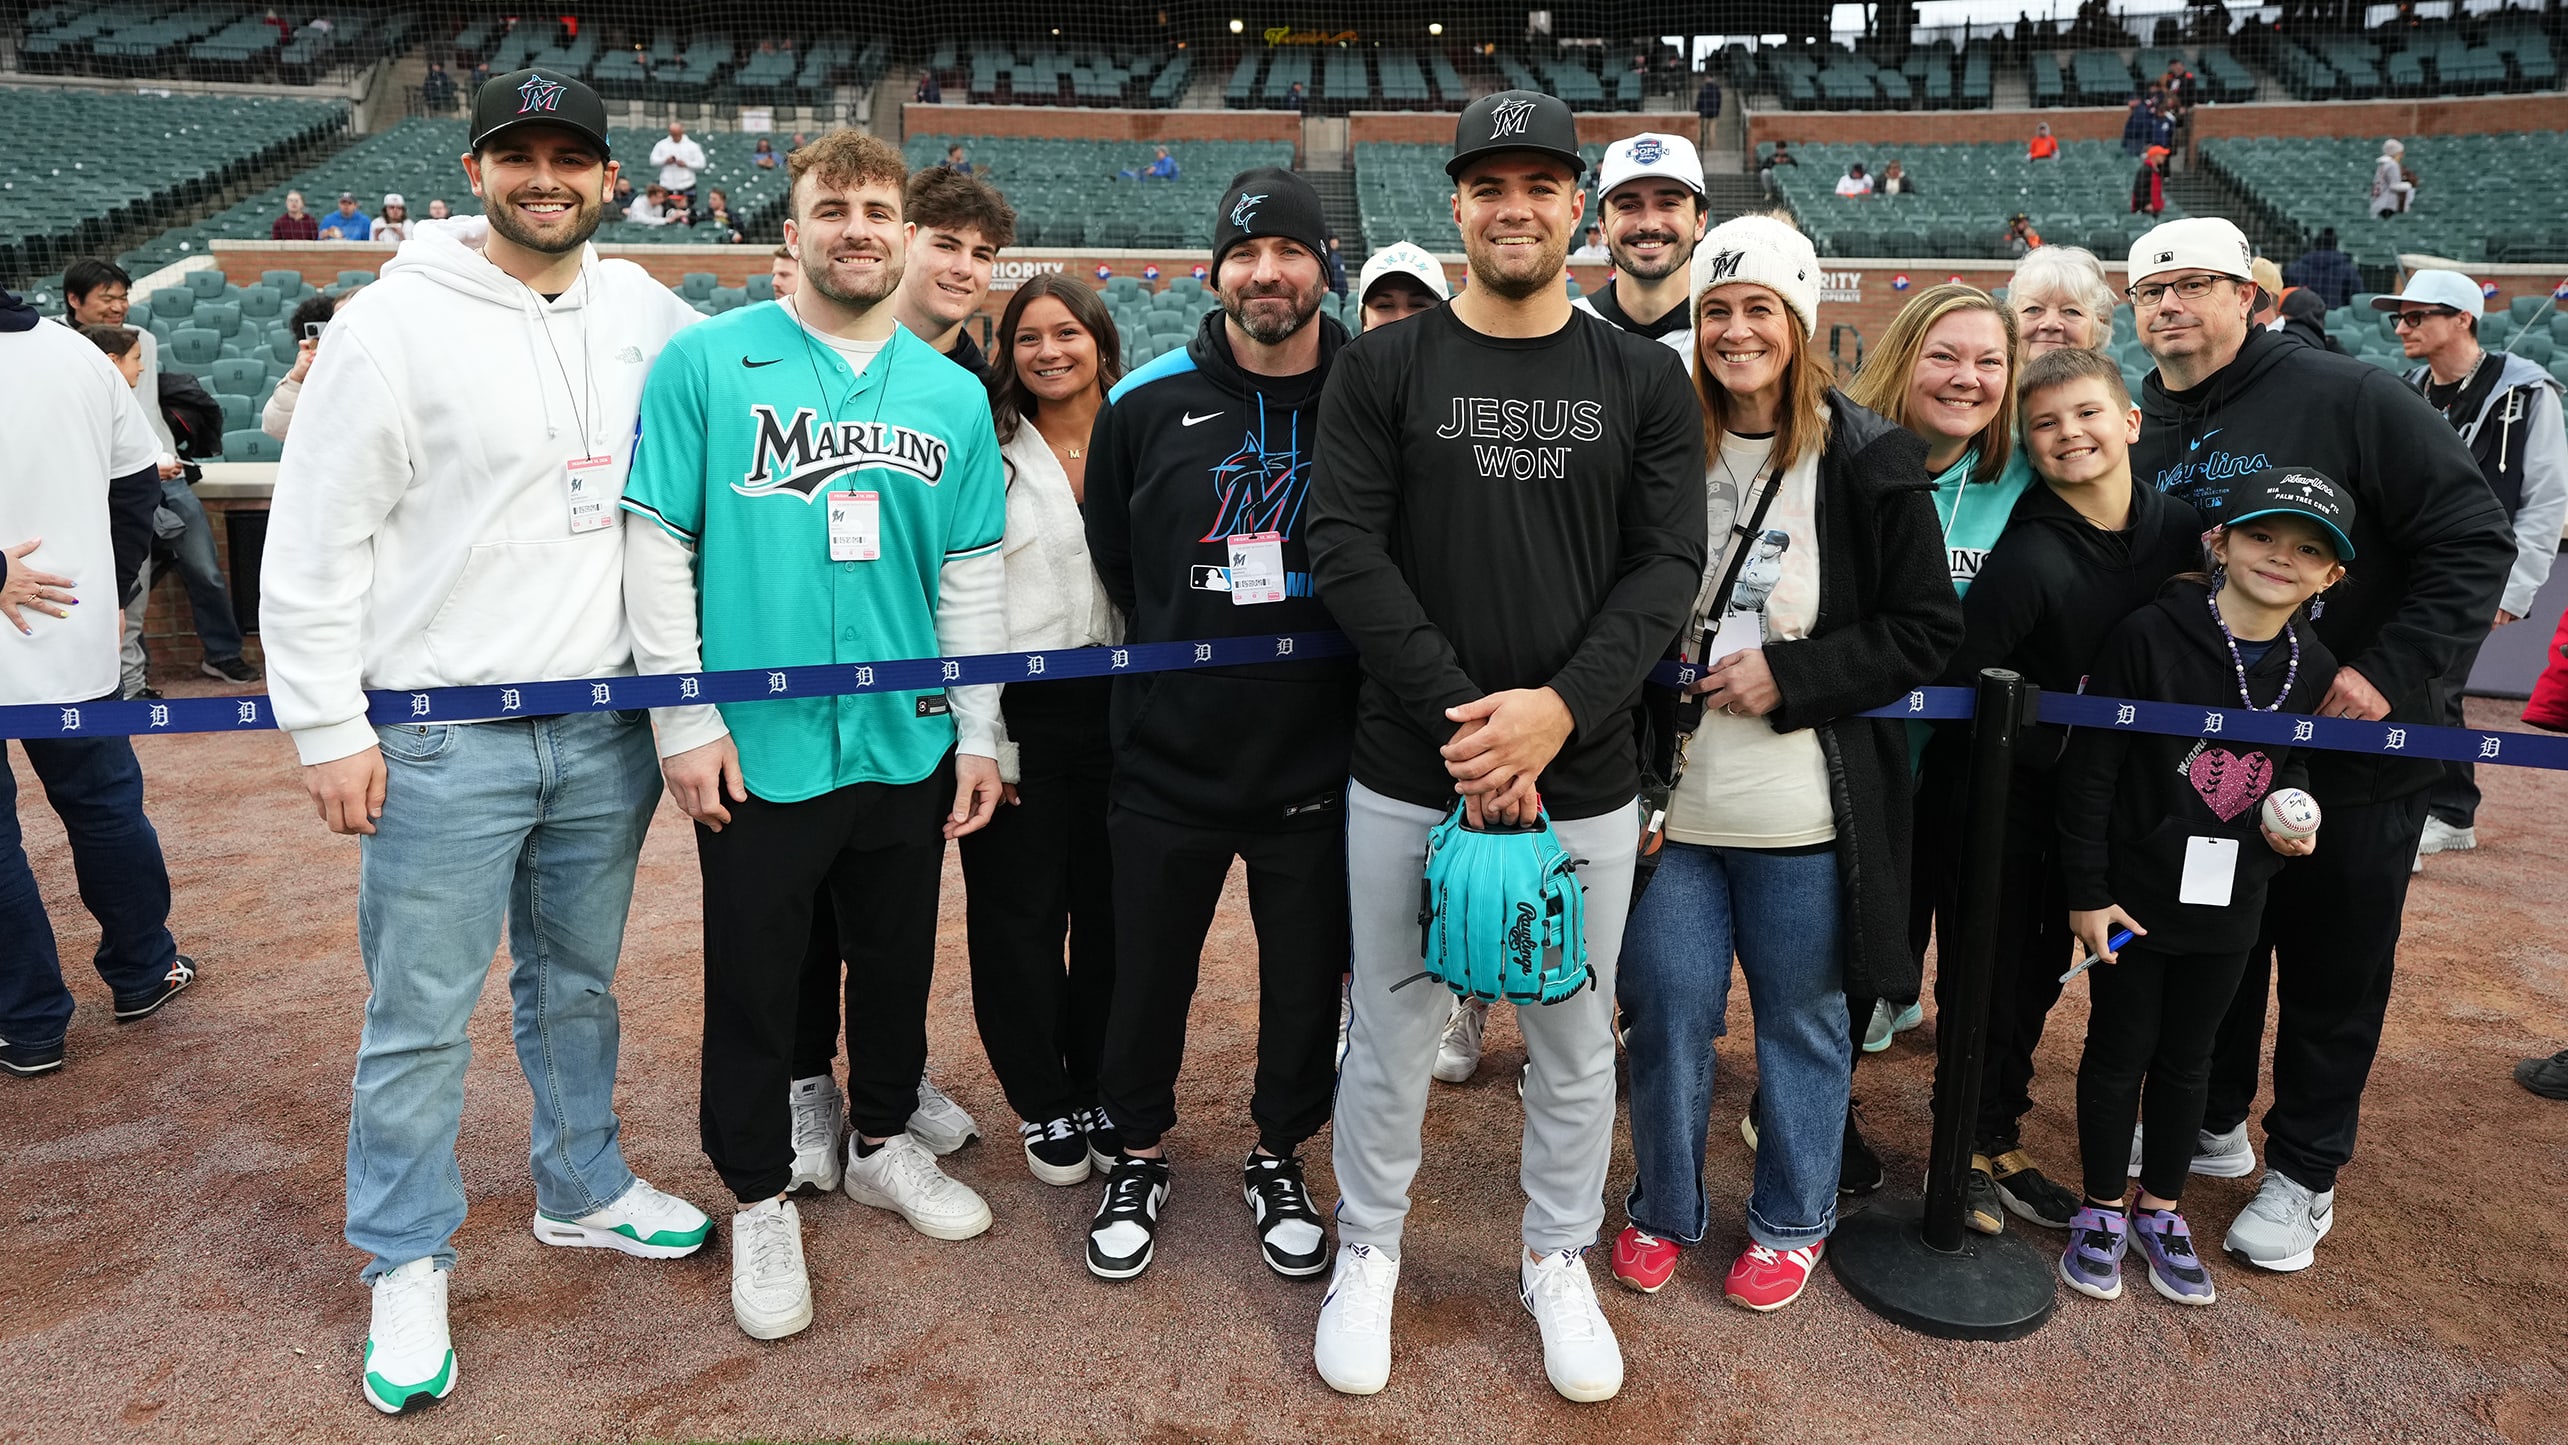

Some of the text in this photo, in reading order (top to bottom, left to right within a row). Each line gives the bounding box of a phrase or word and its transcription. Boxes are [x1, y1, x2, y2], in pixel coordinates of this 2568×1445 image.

[992, 261, 1064, 279] RIORITY
[1821, 272, 1861, 289] RITY
[1436, 397, 1602, 441] JESUS
[746, 405, 949, 486] MARLINS
[1473, 444, 1565, 481] WON
[2267, 487, 2279, 495] MIA
[2275, 493, 2330, 515] PALM TREE CREW
[1513, 902, 1538, 976] Rawlings
